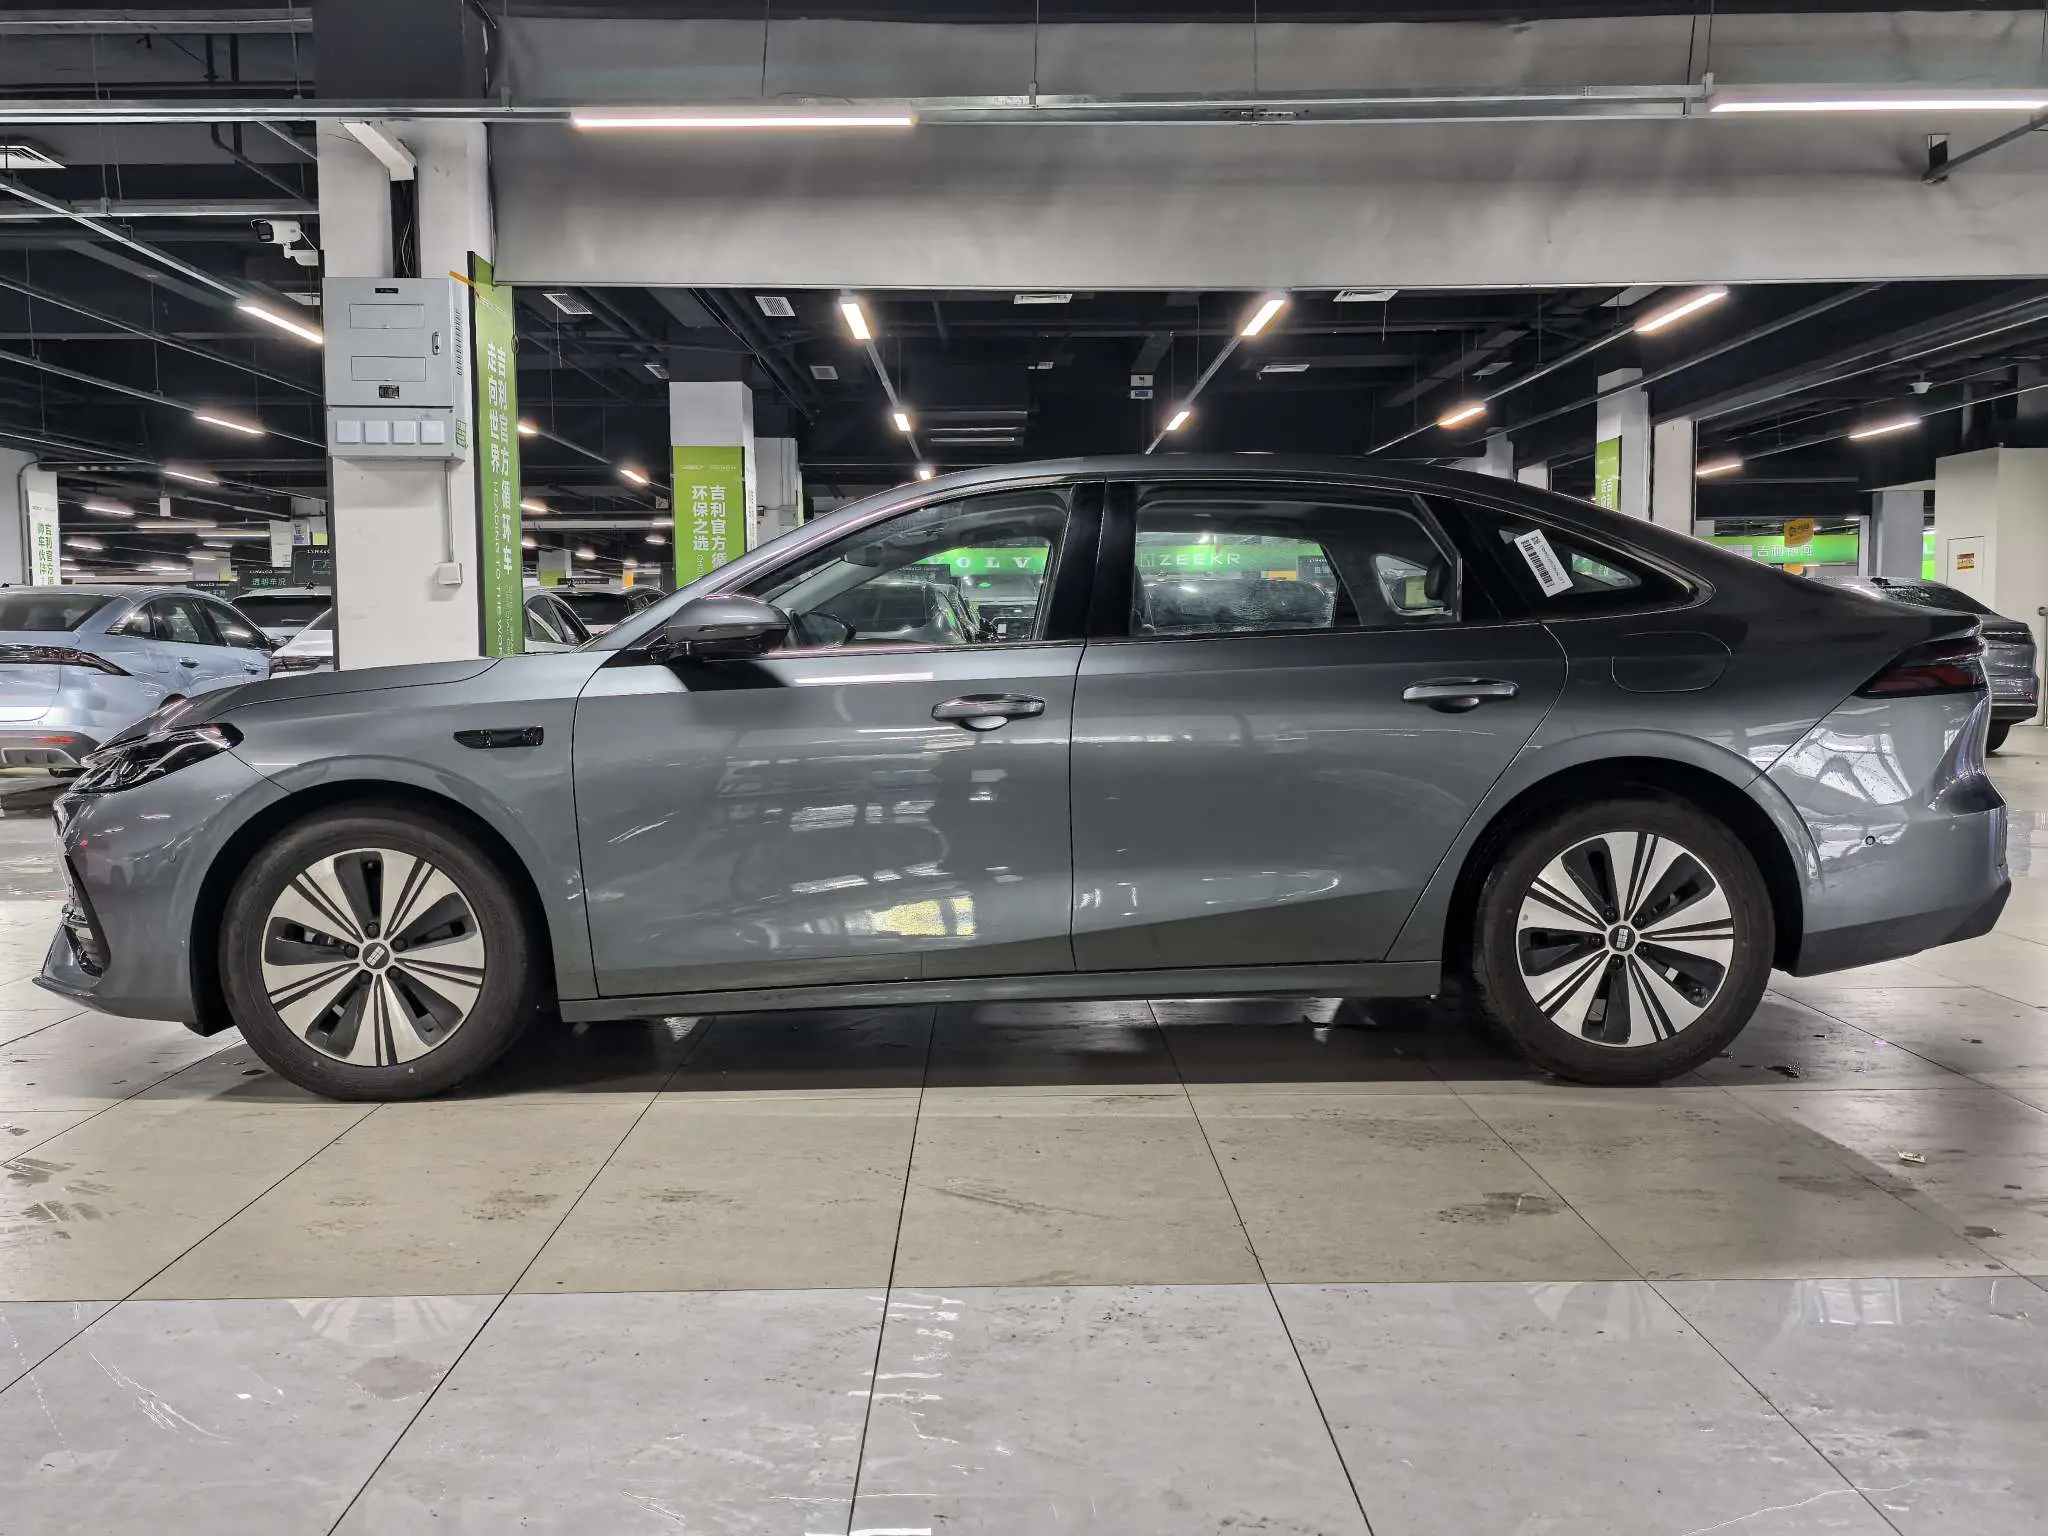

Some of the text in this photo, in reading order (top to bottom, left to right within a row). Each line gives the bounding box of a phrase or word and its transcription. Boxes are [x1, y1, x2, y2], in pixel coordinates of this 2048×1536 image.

[692, 485, 709, 551] 环保之选
[928, 556, 1047, 568] VOLV
[1160, 553, 1240, 566] ZEEKR
[252, 578, 286, 586] 透明车况
